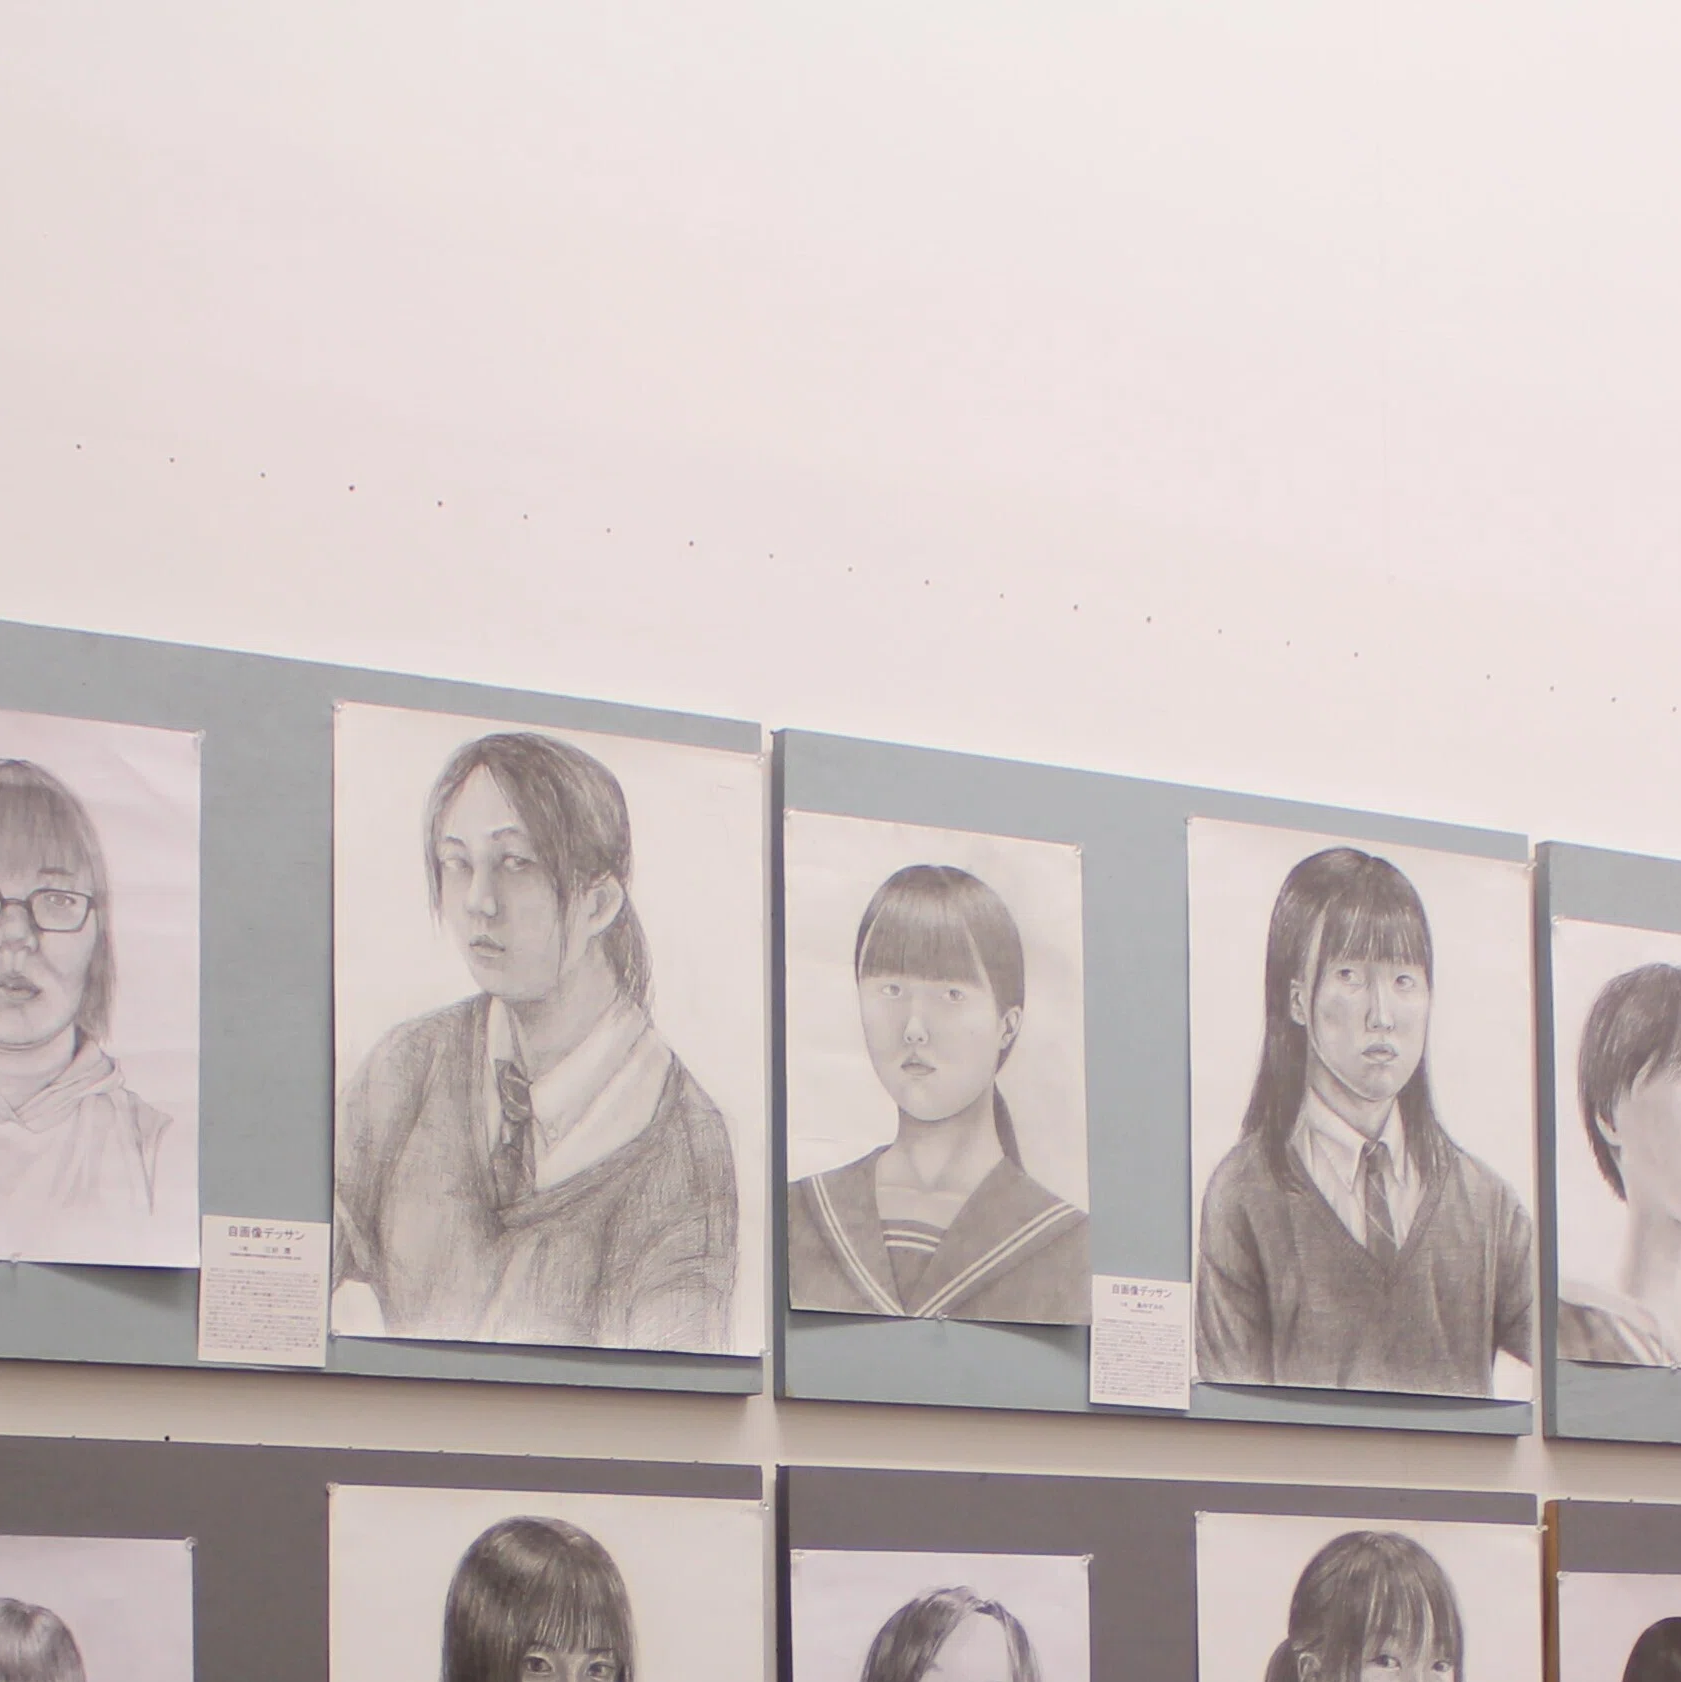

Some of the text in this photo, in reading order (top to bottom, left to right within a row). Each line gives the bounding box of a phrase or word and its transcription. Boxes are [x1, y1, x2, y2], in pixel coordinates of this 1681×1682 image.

[228, 1225, 305, 1240] 自画像デッサン
[1112, 1283, 1172, 1298] 自画像デッサン
